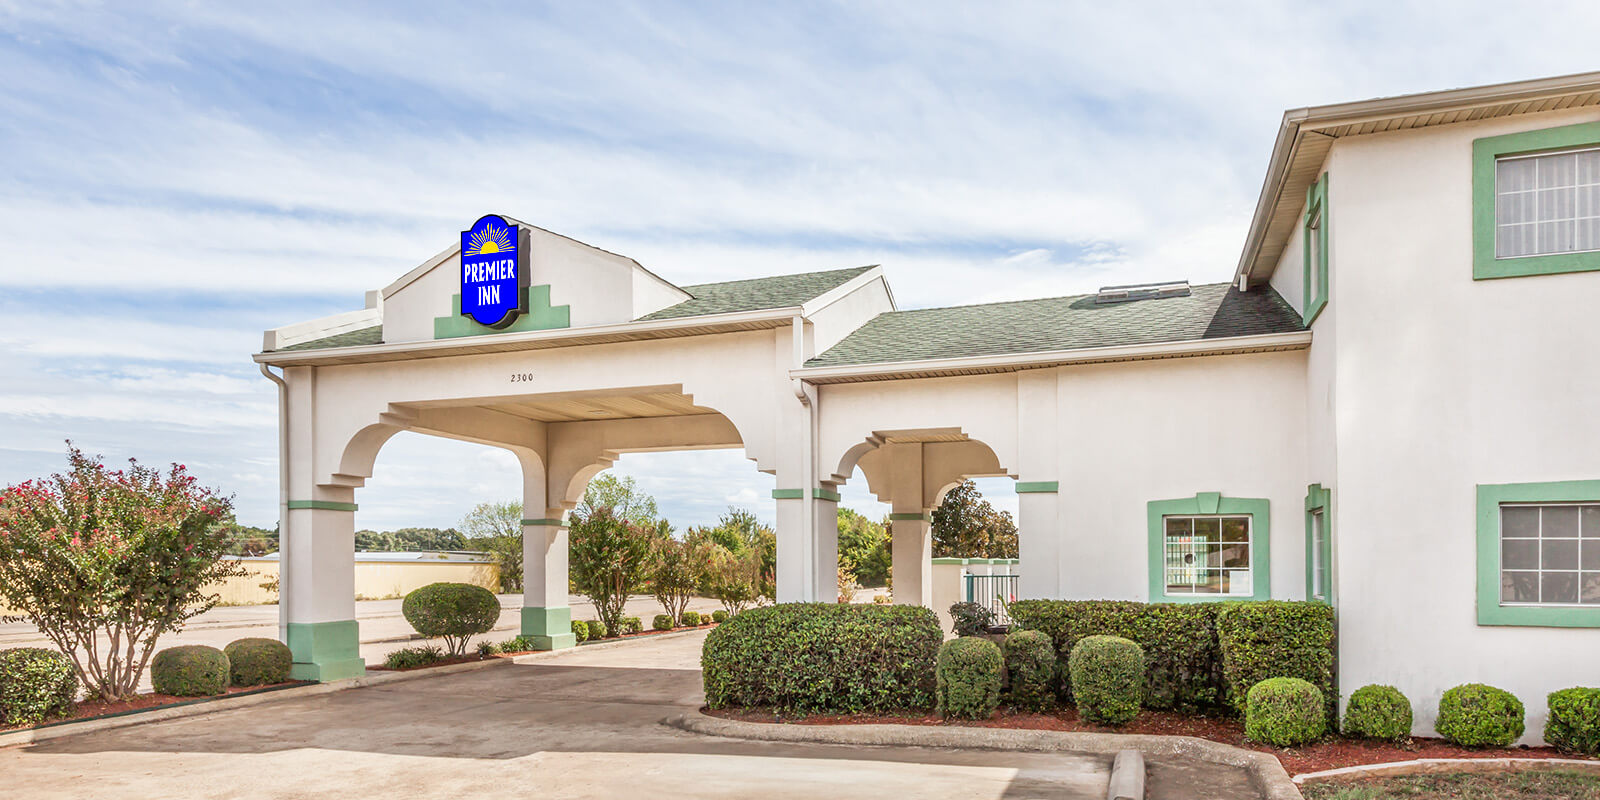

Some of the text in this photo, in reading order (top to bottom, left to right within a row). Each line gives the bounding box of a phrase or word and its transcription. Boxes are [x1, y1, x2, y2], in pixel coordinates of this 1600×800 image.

[464, 259, 515, 284] PREMIER
[478, 284, 501, 306] INN
[510, 373, 533, 383] 2300
